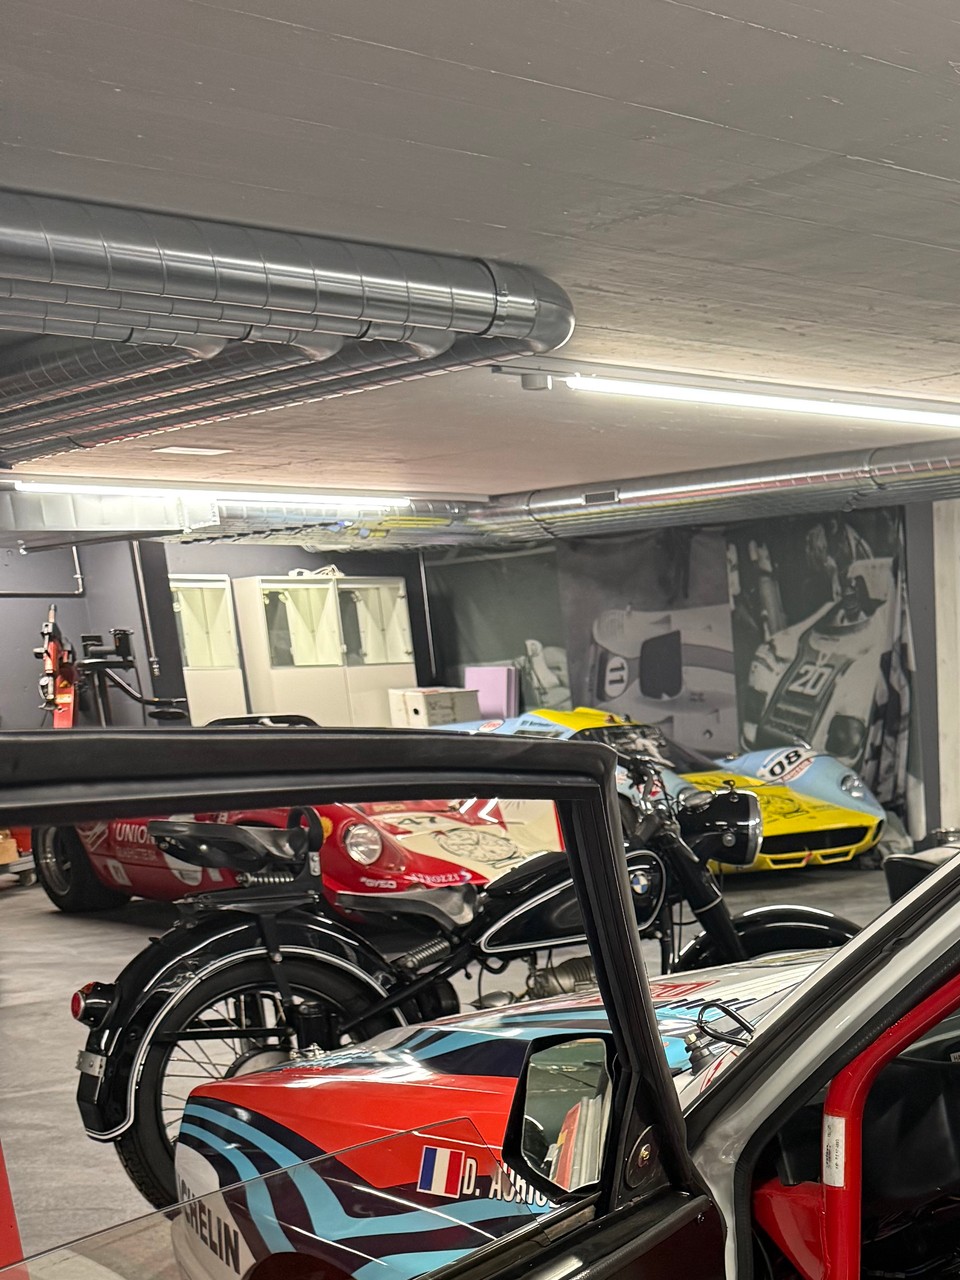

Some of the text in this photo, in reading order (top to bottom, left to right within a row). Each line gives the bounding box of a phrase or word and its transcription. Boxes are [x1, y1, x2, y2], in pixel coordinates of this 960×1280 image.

[608, 662, 625, 685] 11
[788, 664, 834, 697] 20
[769, 750, 802, 777] 08
[463, 1158, 480, 1196] D.
